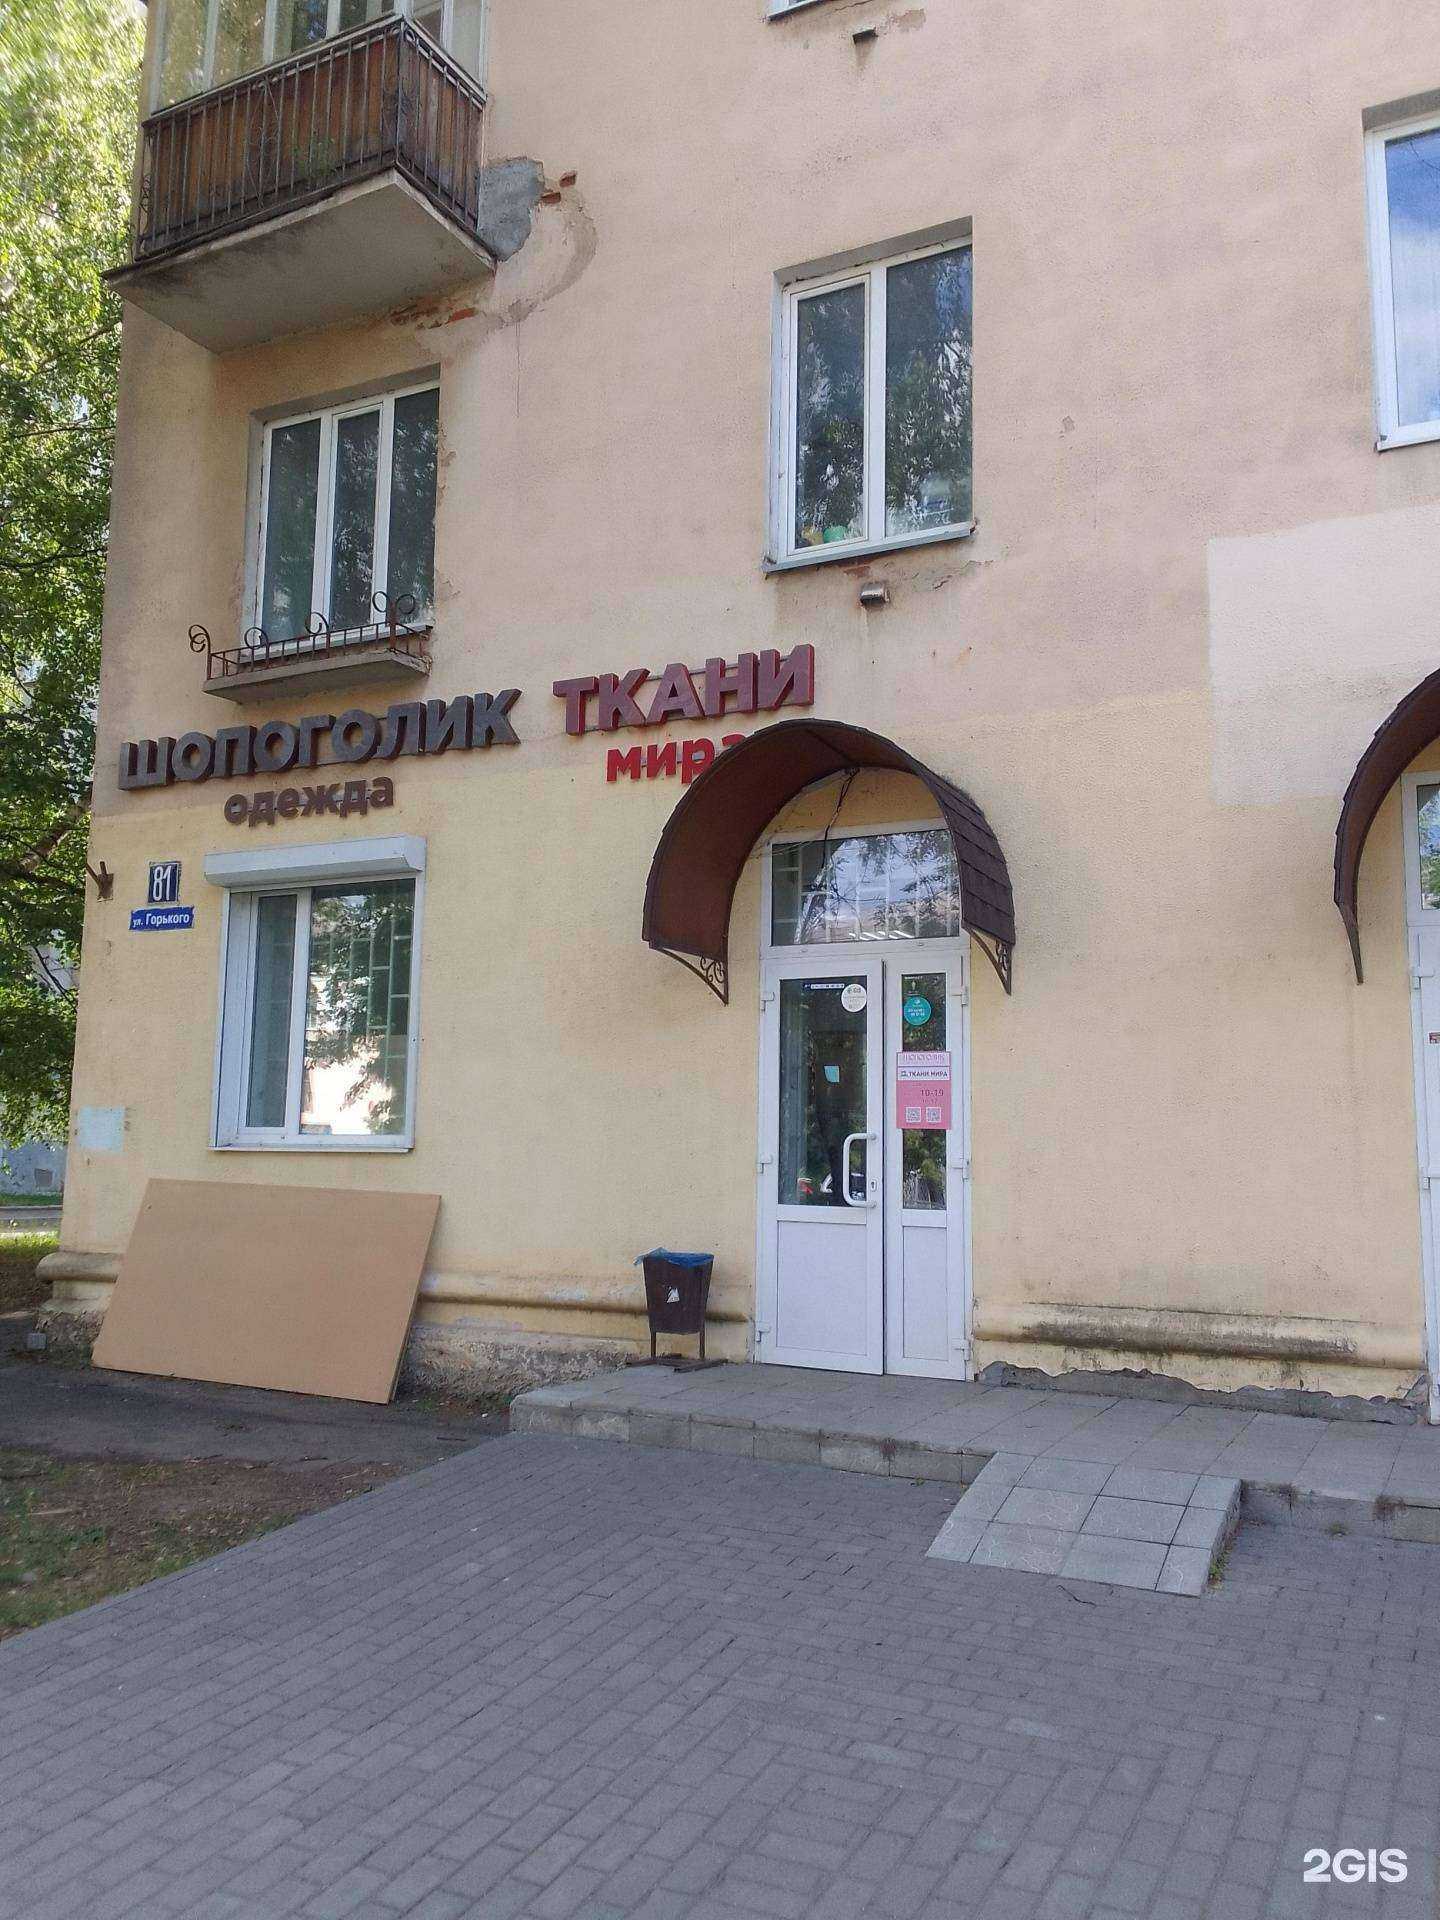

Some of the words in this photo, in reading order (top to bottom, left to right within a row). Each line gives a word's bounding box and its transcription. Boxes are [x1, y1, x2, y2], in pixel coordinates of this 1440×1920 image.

[552, 643, 815, 736] ТКАНИ
[118, 688, 523, 791] ШОПОГОЛИК
[224, 775, 394, 828] одежда
[152, 865, 172, 902] 81
[132, 918, 144, 928] ул.
[145, 912, 190, 927] Горького
